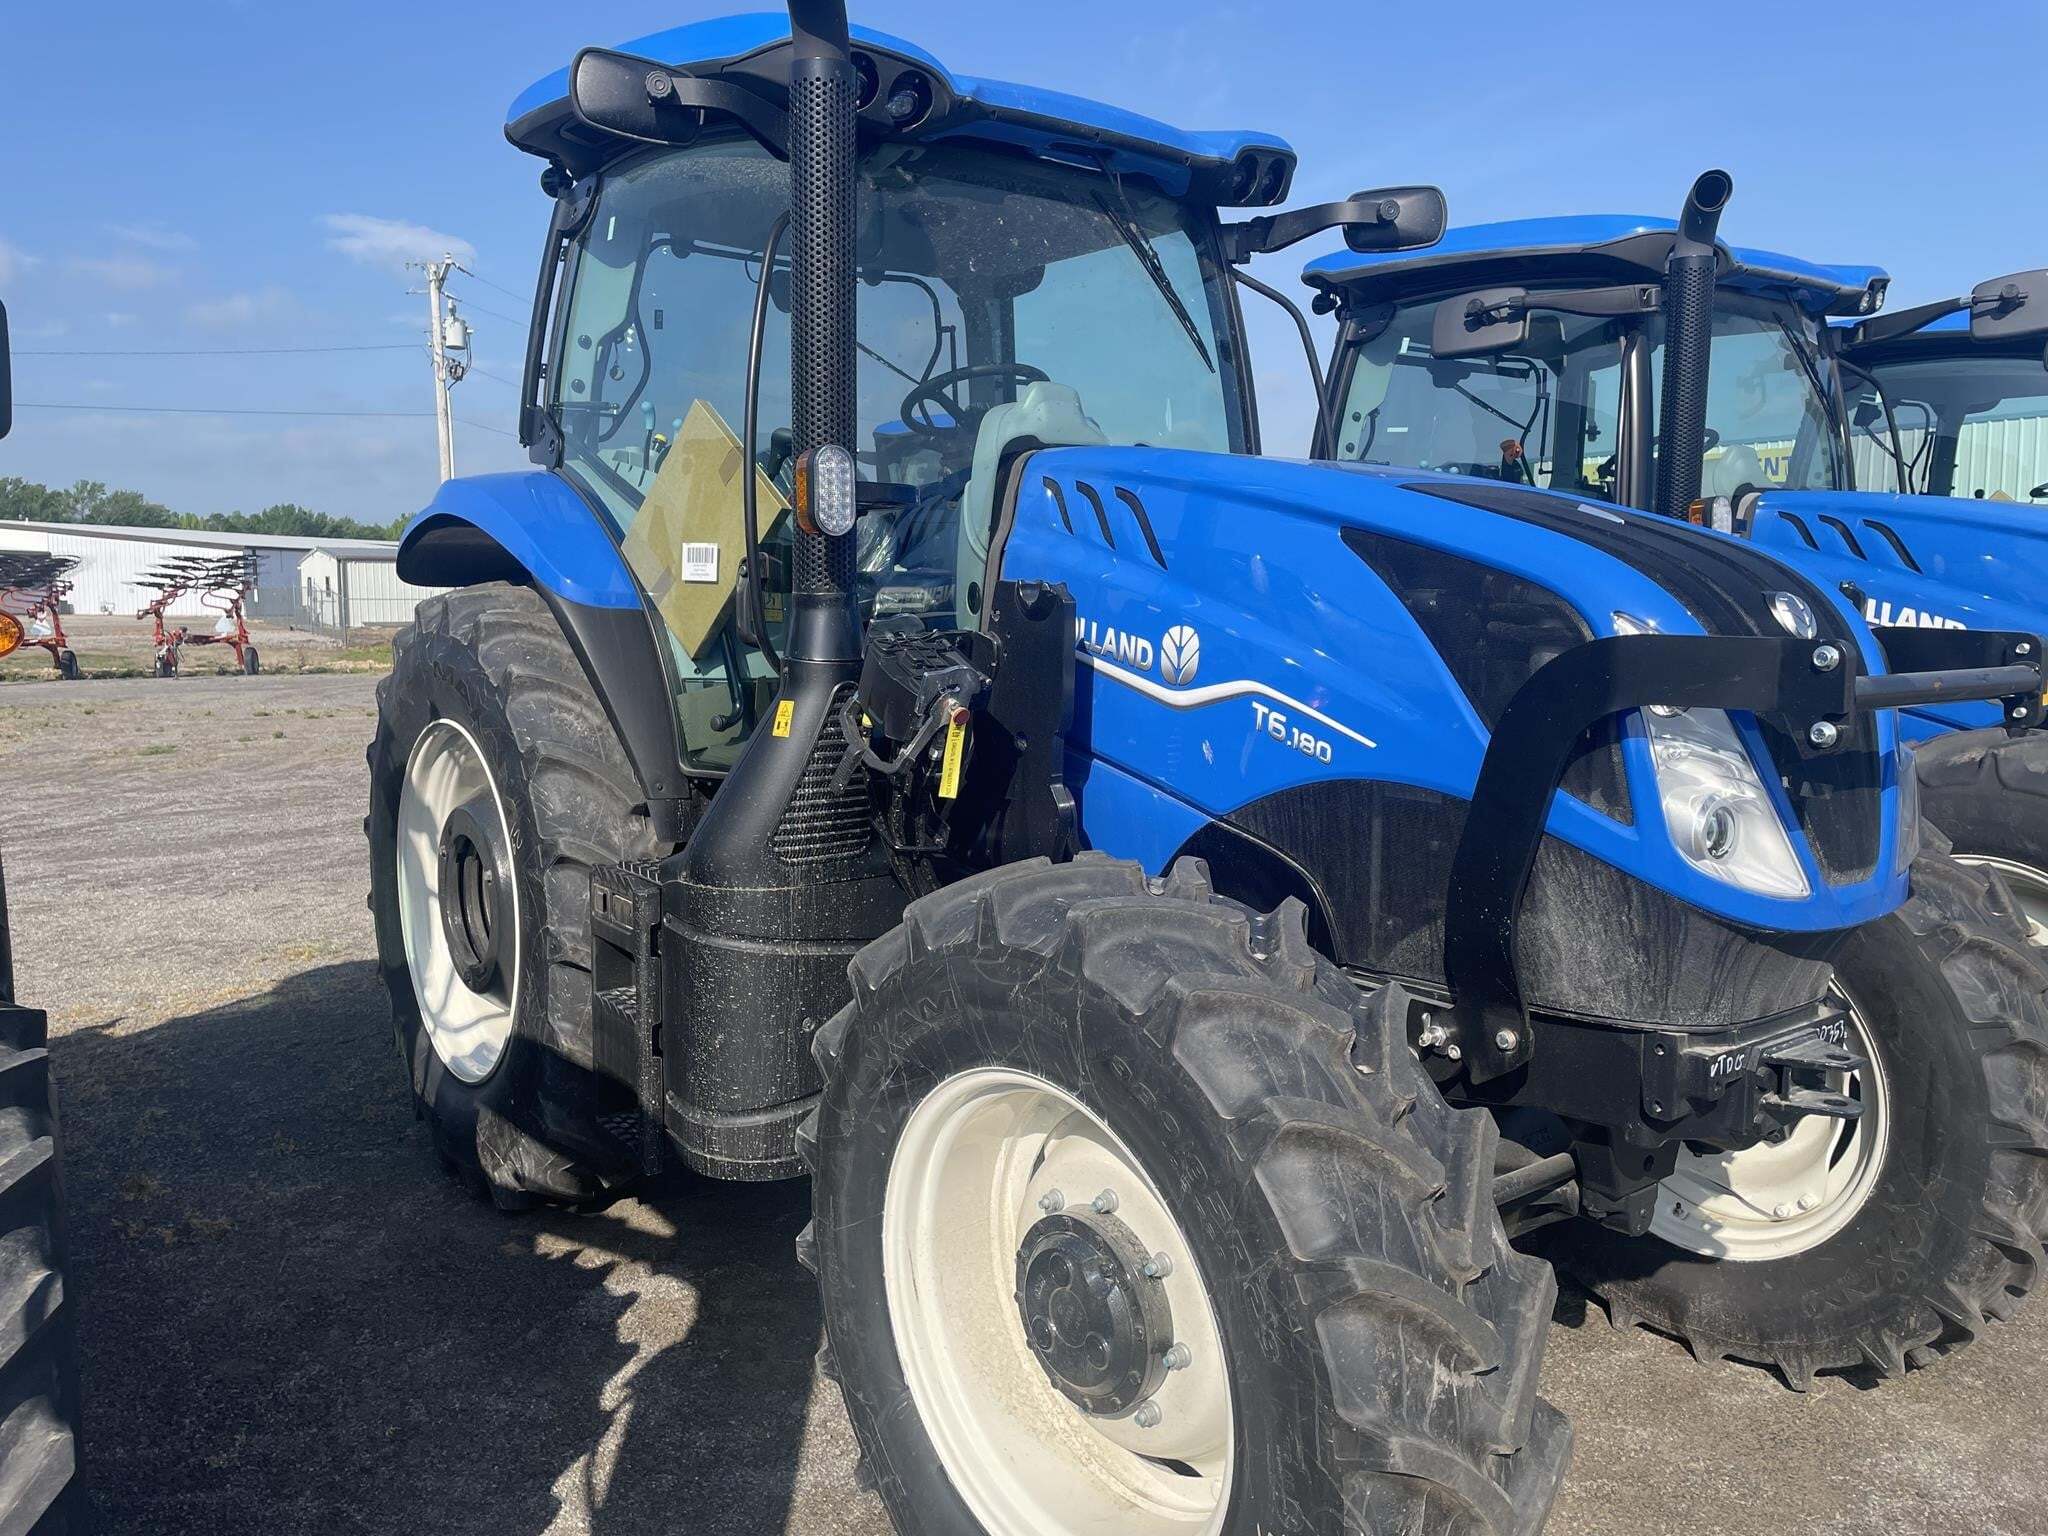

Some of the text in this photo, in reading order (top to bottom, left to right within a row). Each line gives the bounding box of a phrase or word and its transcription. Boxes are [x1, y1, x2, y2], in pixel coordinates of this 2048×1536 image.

[1758, 456, 1792, 476] NT
[1075, 615, 1154, 671] LLAND
[1252, 701, 1332, 764] T6.180
